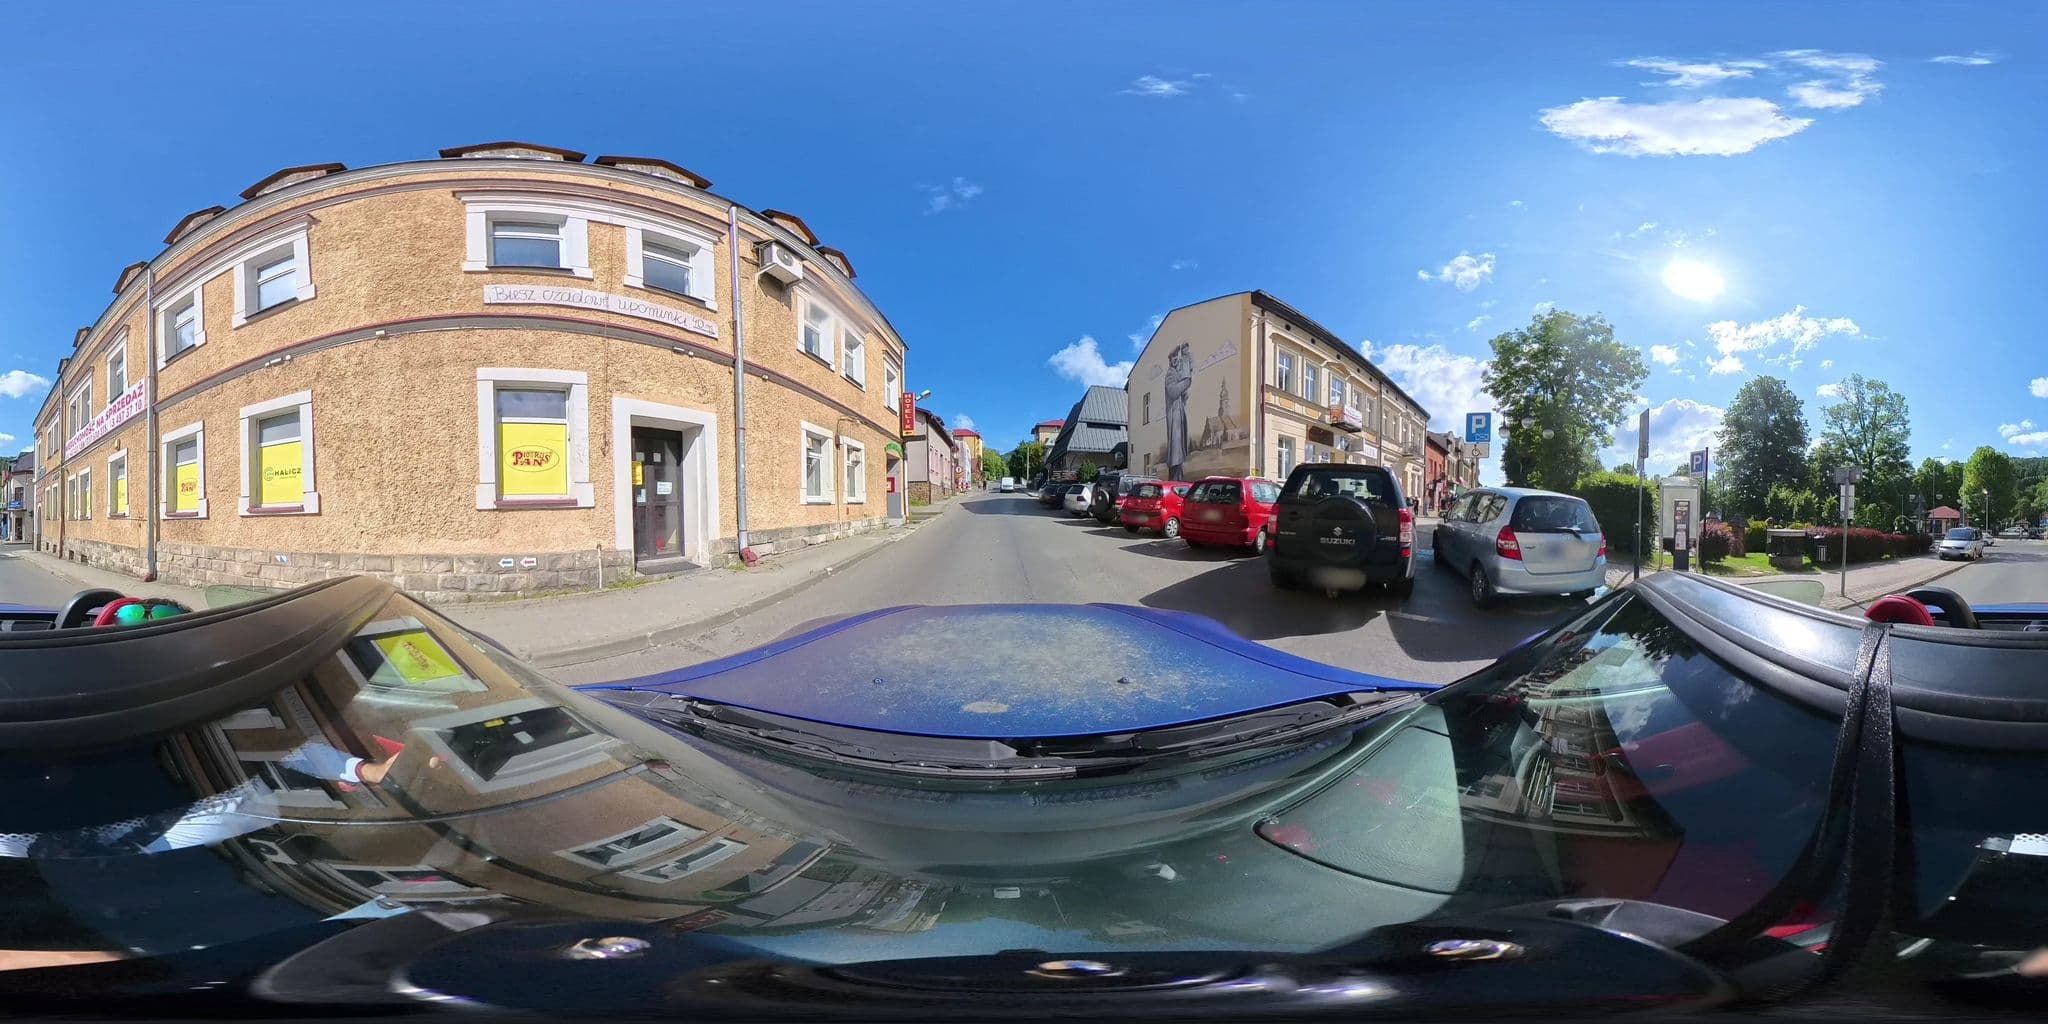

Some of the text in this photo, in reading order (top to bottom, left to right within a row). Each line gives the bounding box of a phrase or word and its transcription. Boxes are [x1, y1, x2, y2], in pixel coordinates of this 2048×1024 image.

[105, 382, 144, 420] SPRZEDAŻ
[904, 393, 912, 429] HOTELIK
[1472, 415, 1486, 434] P
[1693, 455, 1702, 470] P
[275, 467, 302, 476] HALICZ
[1320, 537, 1356, 545] SUZUKI
